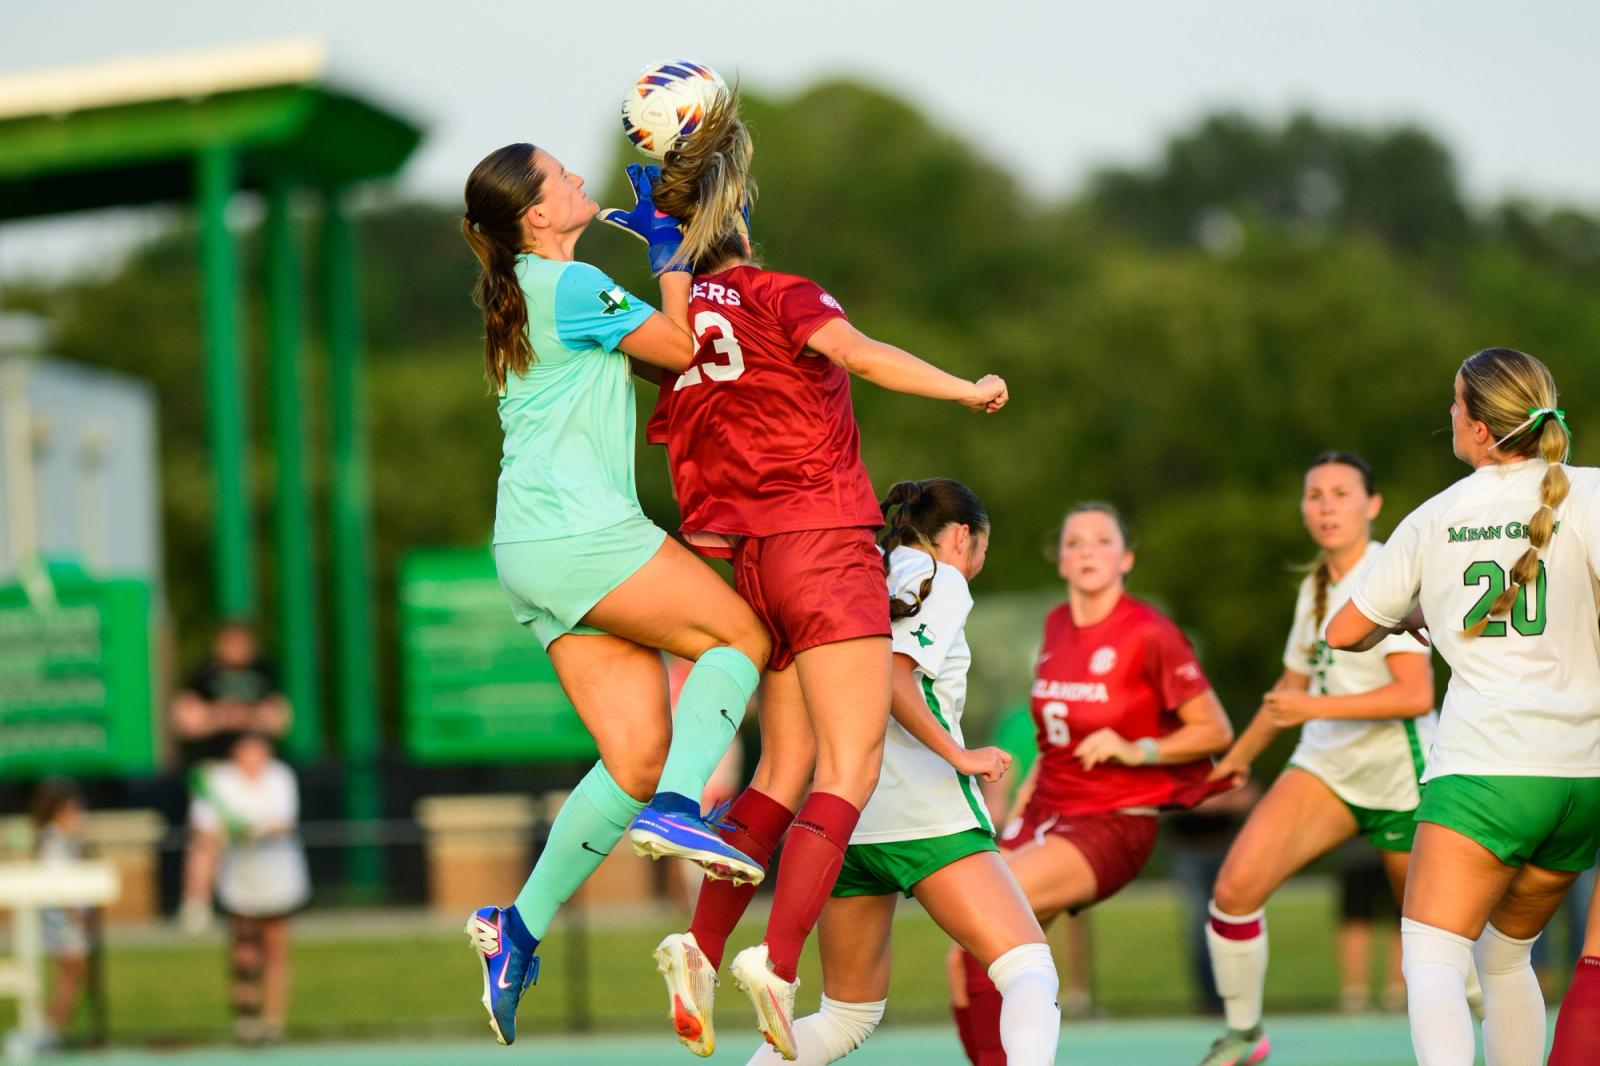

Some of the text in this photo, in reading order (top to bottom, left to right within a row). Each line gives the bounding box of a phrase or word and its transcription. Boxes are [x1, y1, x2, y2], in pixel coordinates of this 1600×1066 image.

[688, 282, 741, 305] ERS
[1448, 521, 1560, 543] MEAN GRN
[1463, 560, 1547, 637] 20
[1042, 701, 1071, 747] 6
